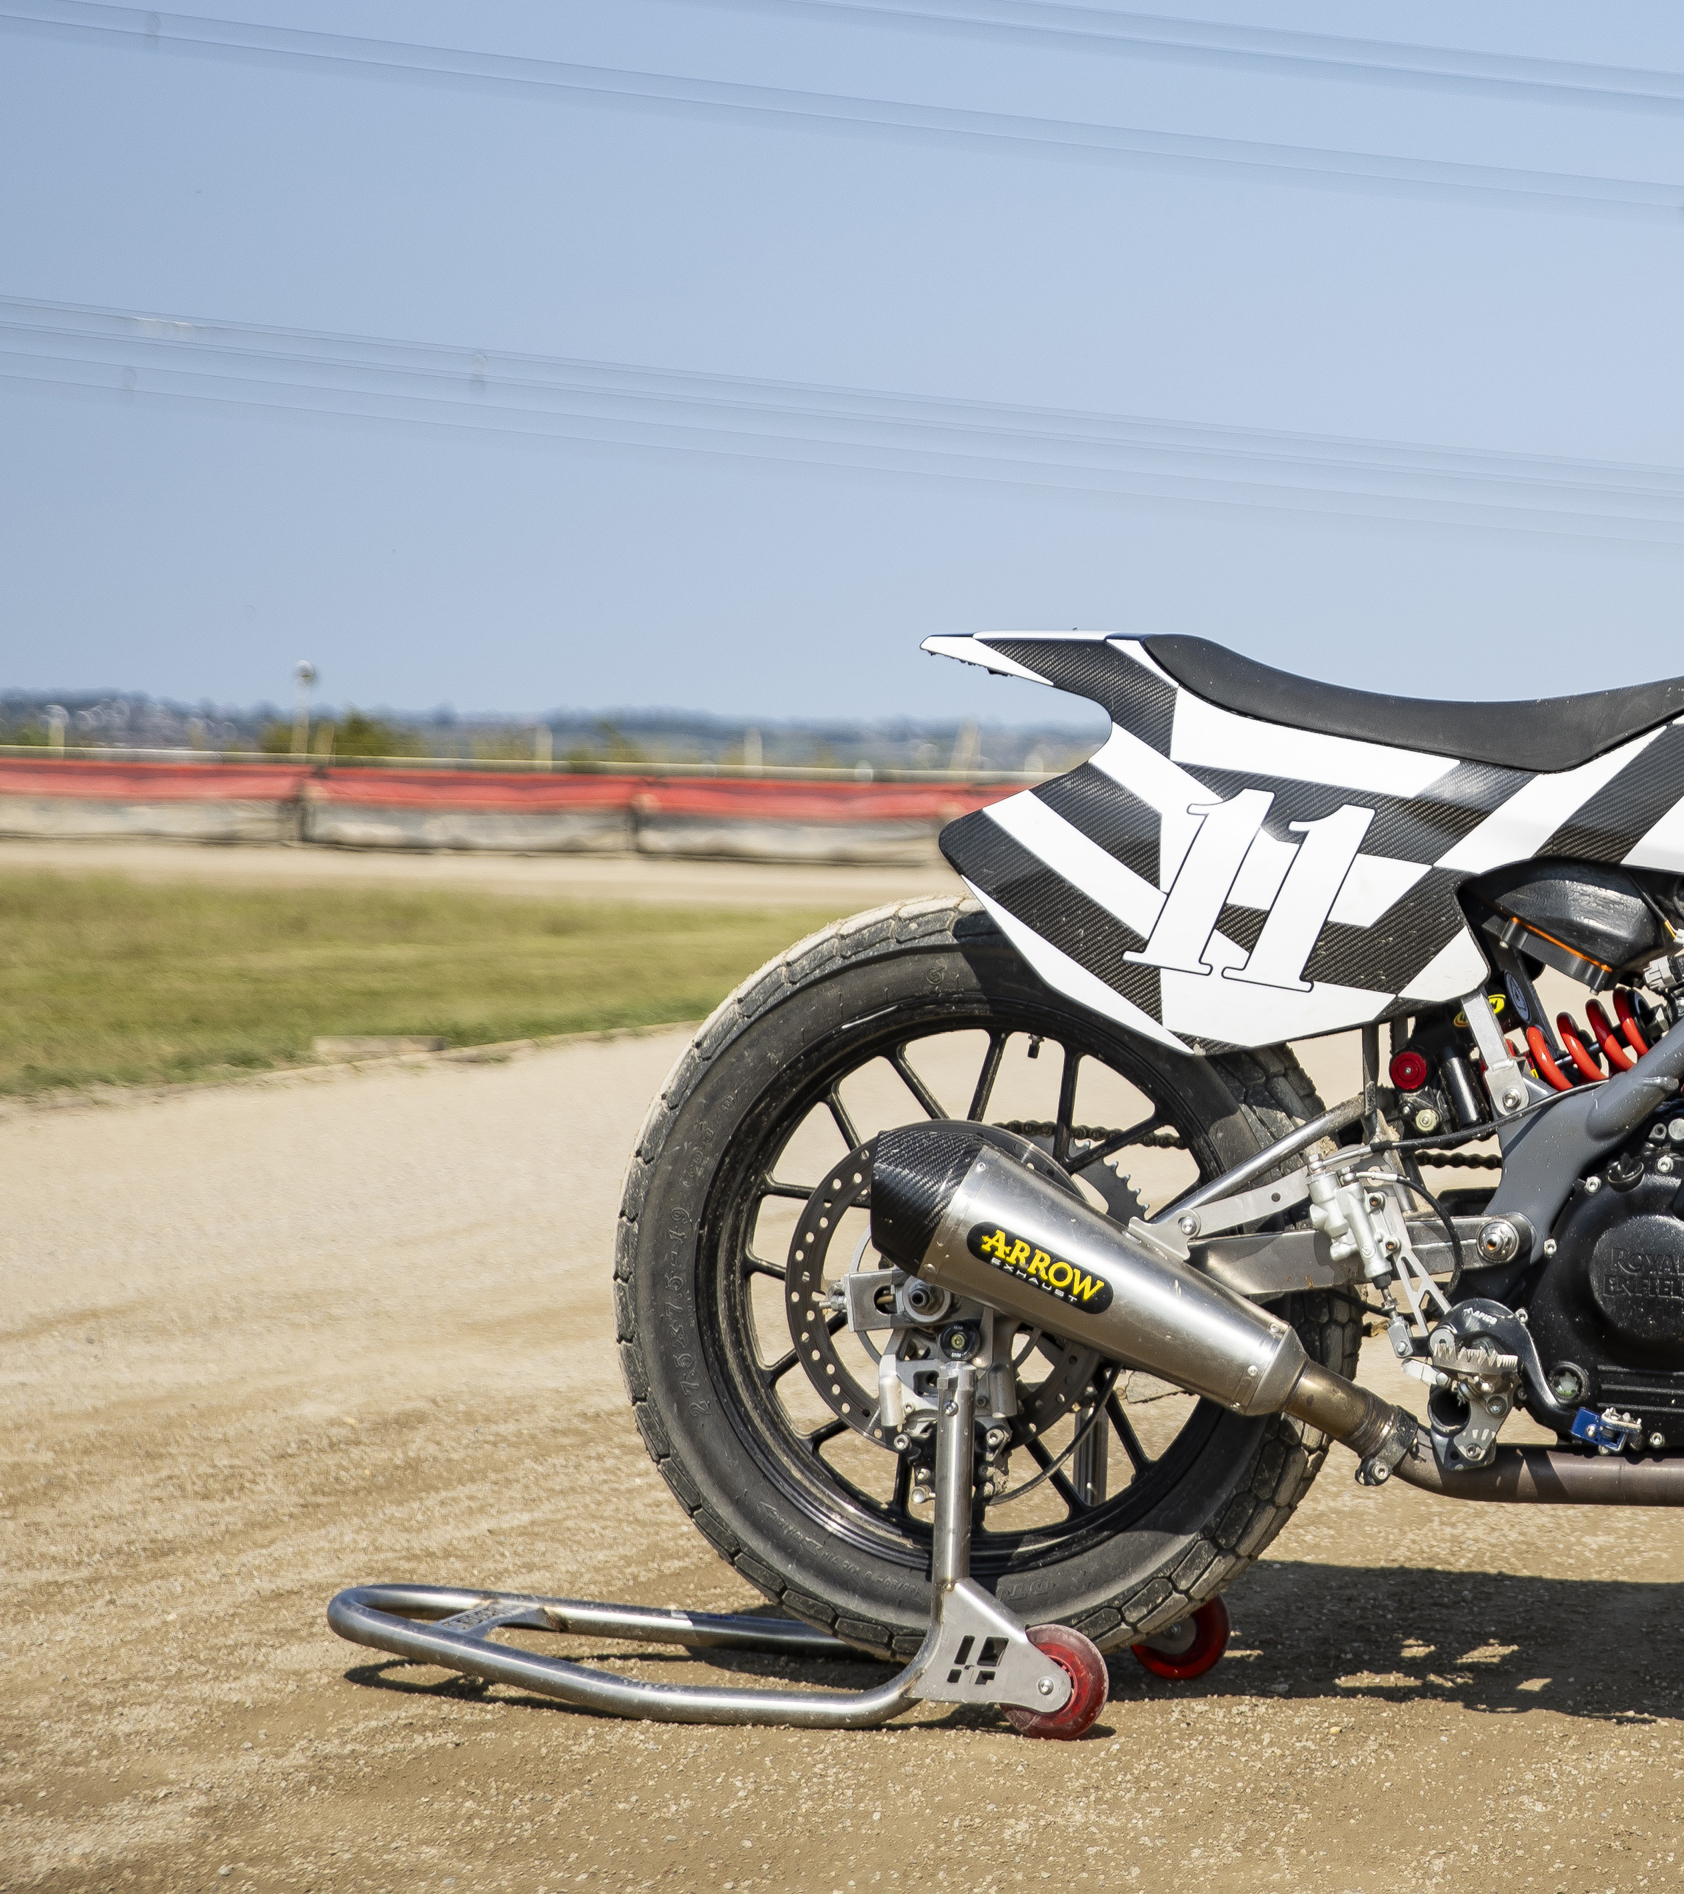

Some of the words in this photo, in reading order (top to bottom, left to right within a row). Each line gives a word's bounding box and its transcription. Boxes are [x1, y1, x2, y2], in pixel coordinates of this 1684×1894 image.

[1123, 789, 1375, 992] 11
[981, 1229, 1105, 1300] ARROW
[990, 1257, 1078, 1303] EXHAUST
[1474, 1310, 1498, 1325] APICO
